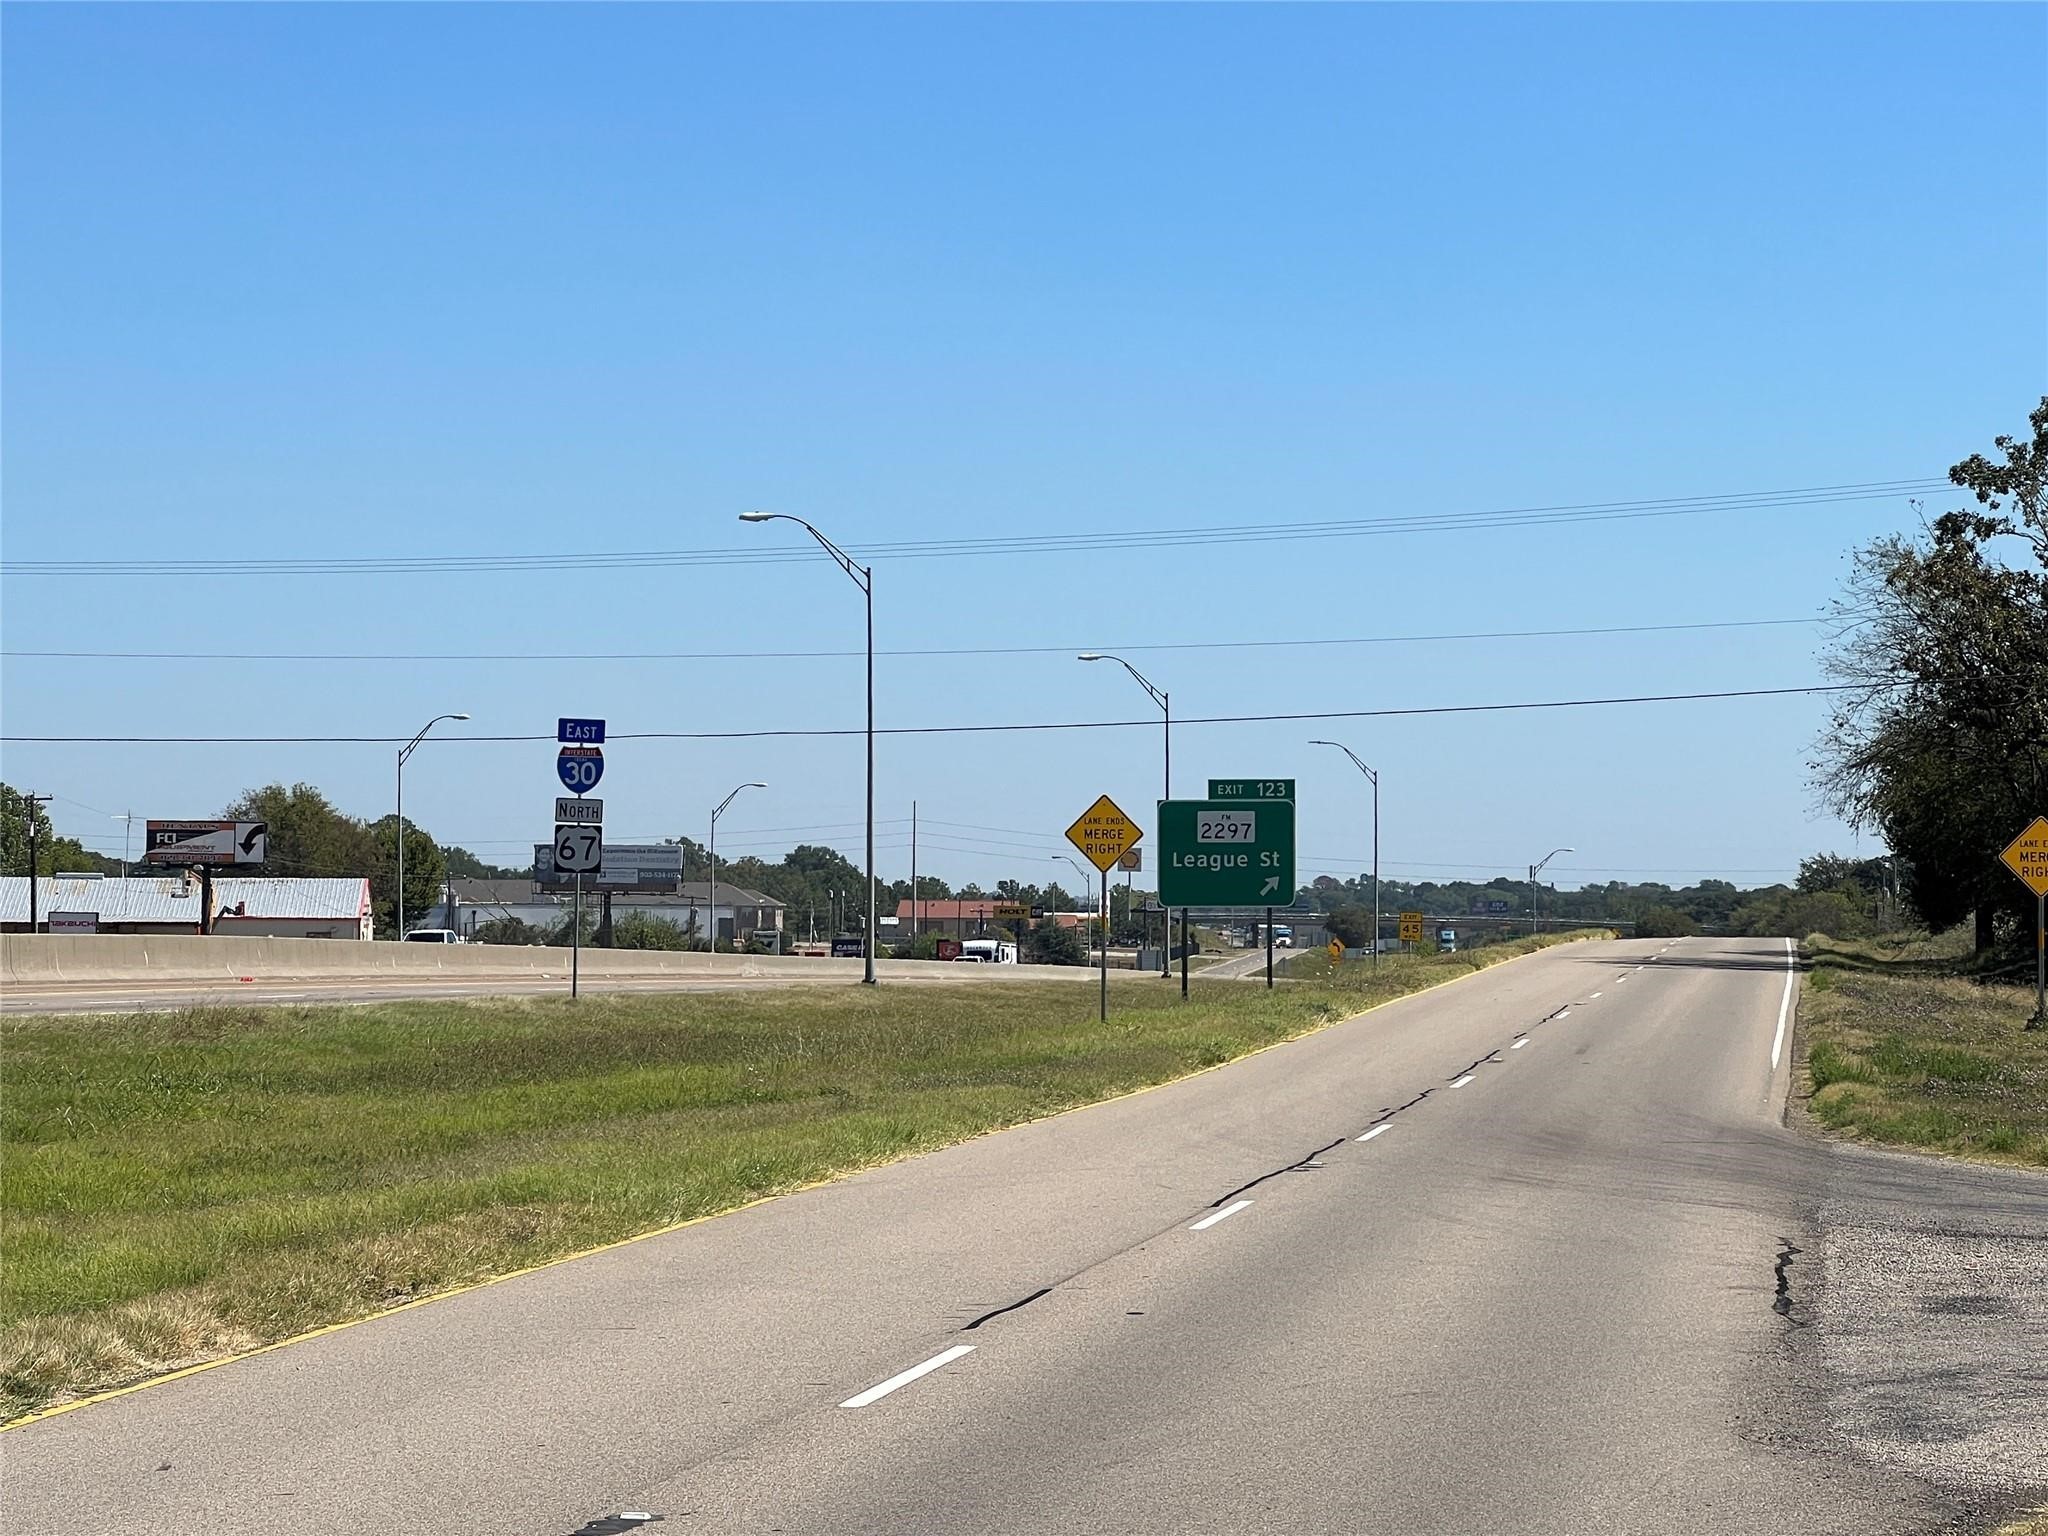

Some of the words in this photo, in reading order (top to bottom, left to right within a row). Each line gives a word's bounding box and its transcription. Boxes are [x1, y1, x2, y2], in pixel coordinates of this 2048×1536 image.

[565, 723, 597, 739] EAST
[564, 761, 596, 785] 30
[1217, 784, 1244, 795] EXIT
[1257, 782, 1286, 797] 123
[559, 803, 599, 819] NORTH
[1084, 817, 1102, 825] LANE
[1106, 817, 1125, 825] ENDS
[1084, 829, 1124, 840] MERGE
[1201, 823, 1252, 839] 2297
[156, 832, 177, 844] FCI
[2020, 840, 2039, 848] LANE
[559, 835, 597, 861] 67
[1086, 843, 1123, 854] RIGHT
[1172, 851, 1249, 872] League
[1259, 851, 1280, 867] St
[2020, 852, 2048, 862] MER
[1403, 924, 1419, 933] 45
